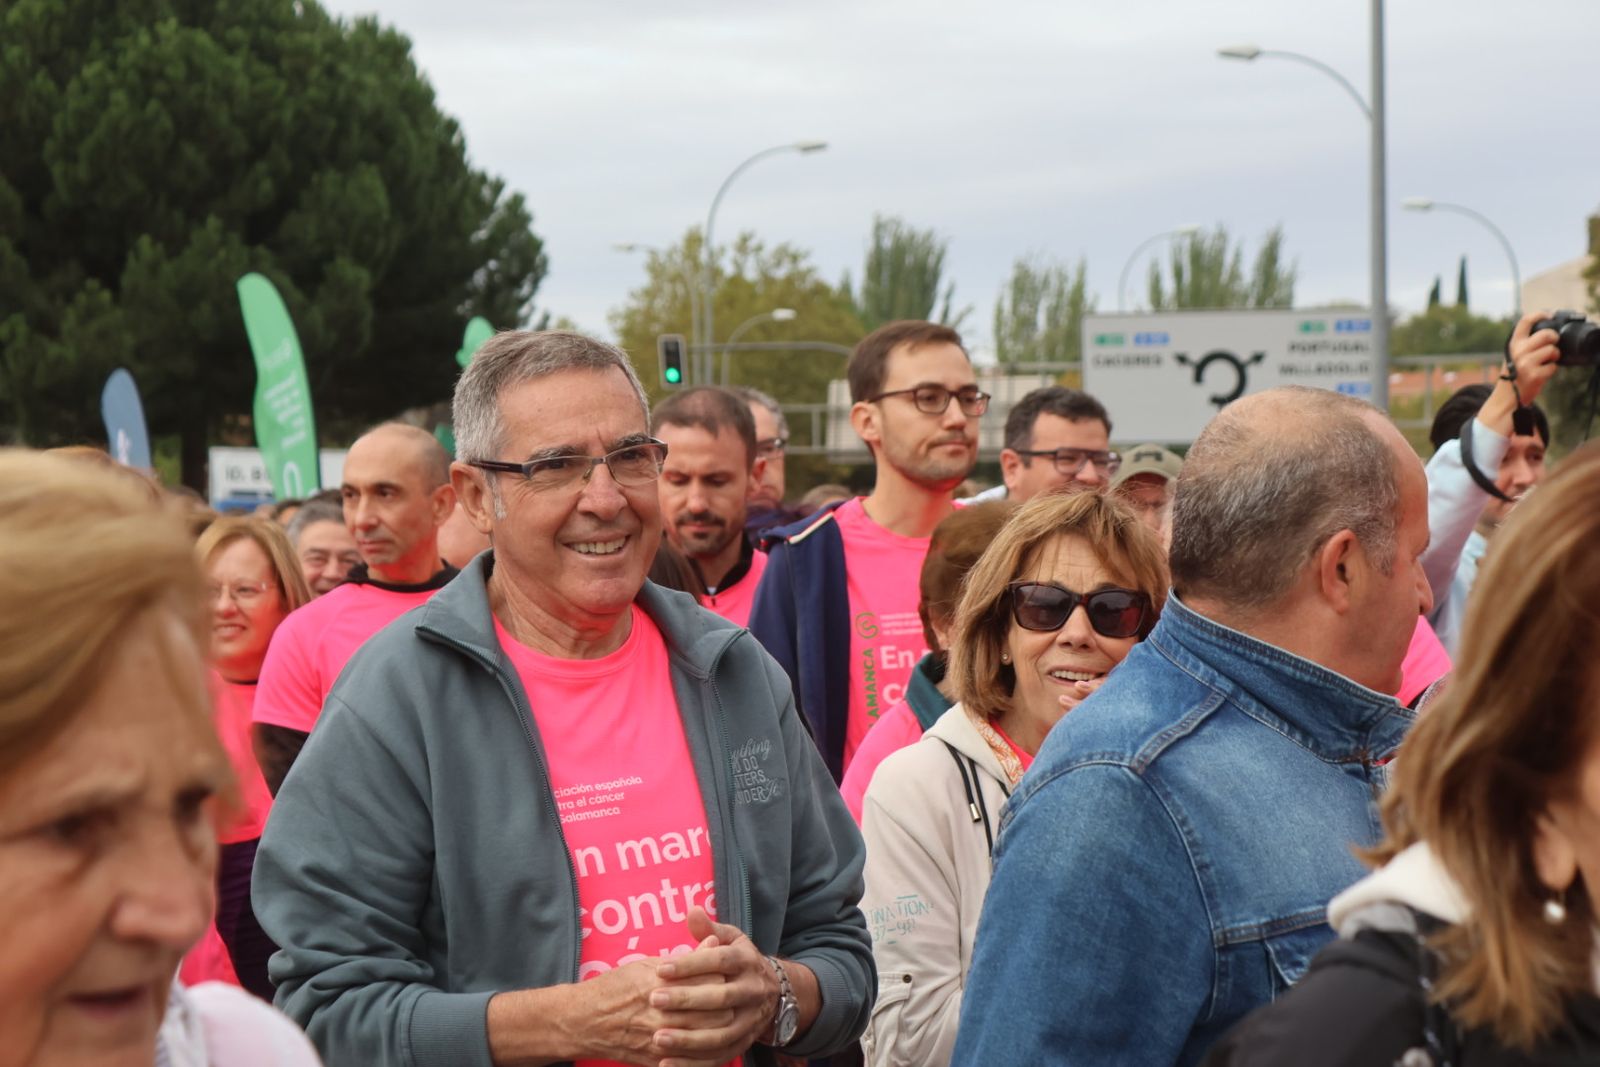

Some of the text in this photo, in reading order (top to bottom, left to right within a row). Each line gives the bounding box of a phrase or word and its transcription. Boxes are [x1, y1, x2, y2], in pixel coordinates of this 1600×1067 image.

[880, 645, 916, 670] En
[594, 776, 642, 792] española
[576, 796, 587, 808] el
[560, 806, 621, 824] Salamanca
[615, 826, 712, 871] mar
